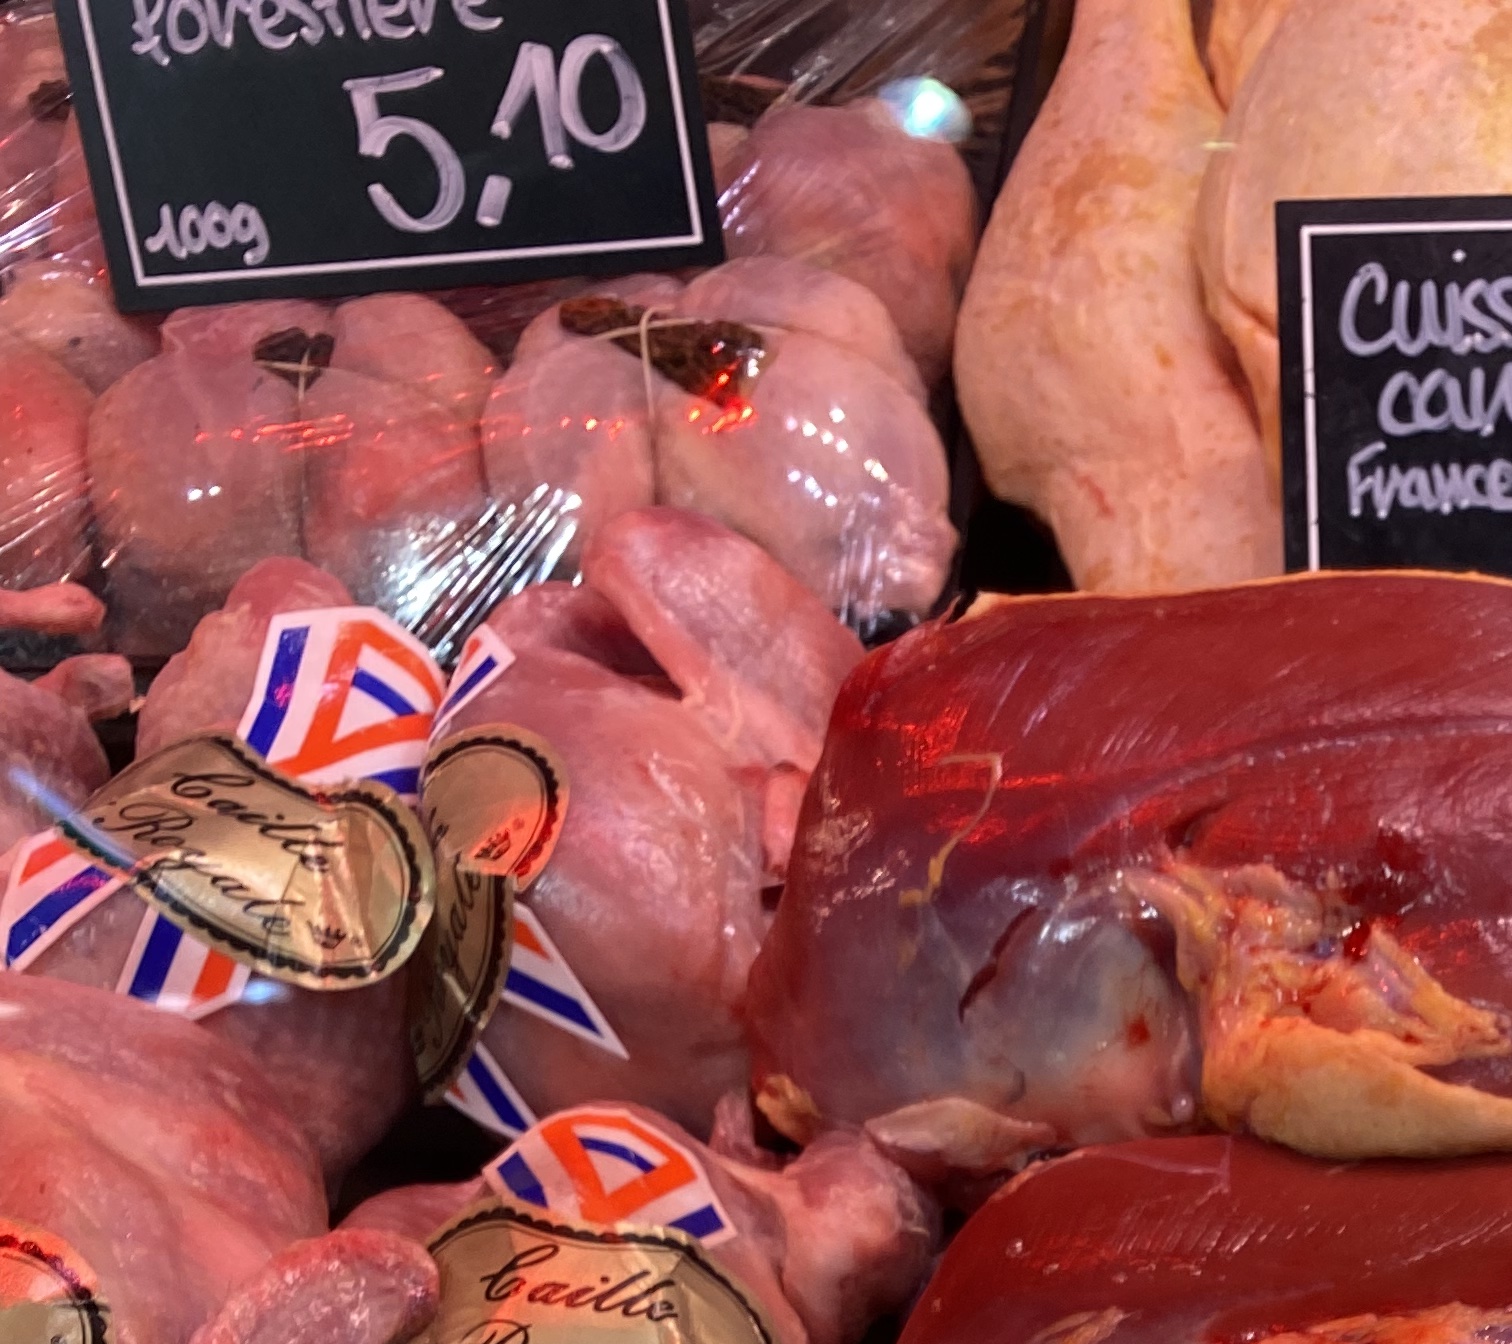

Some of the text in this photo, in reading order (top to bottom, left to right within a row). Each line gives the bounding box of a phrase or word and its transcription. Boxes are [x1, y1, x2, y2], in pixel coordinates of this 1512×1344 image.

[343, 34, 646, 232] 5,10
[145, 201, 270, 265] 100g
[480, 1244, 679, 1321] Caille
